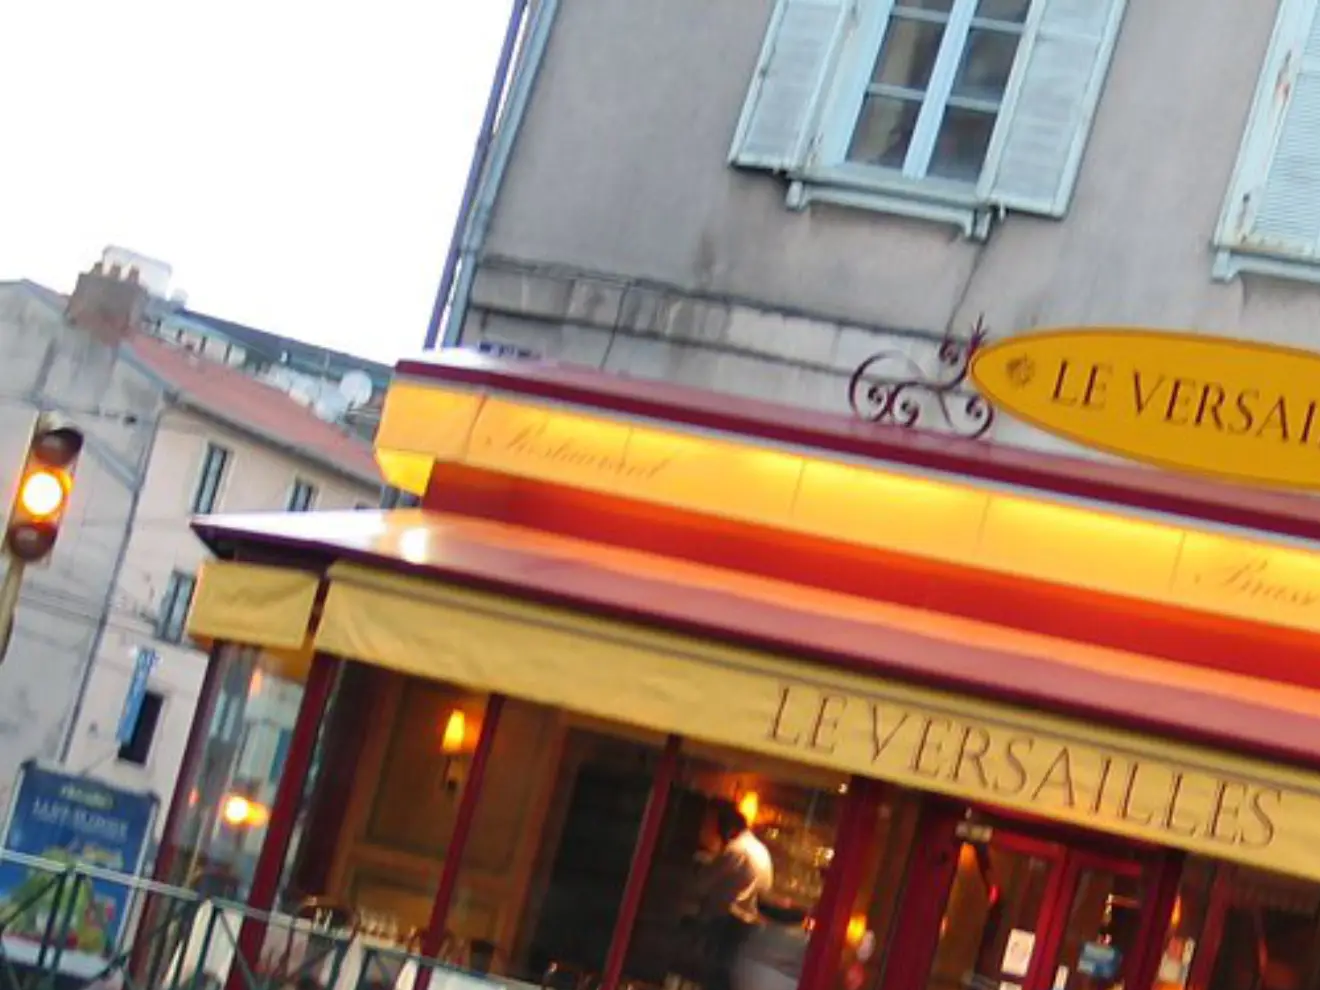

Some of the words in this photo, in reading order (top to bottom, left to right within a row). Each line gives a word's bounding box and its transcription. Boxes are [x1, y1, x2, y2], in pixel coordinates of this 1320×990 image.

[1051, 359, 1113, 409] LE
[767, 686, 848, 752] LE
[868, 702, 1282, 850] VERSAILLES
